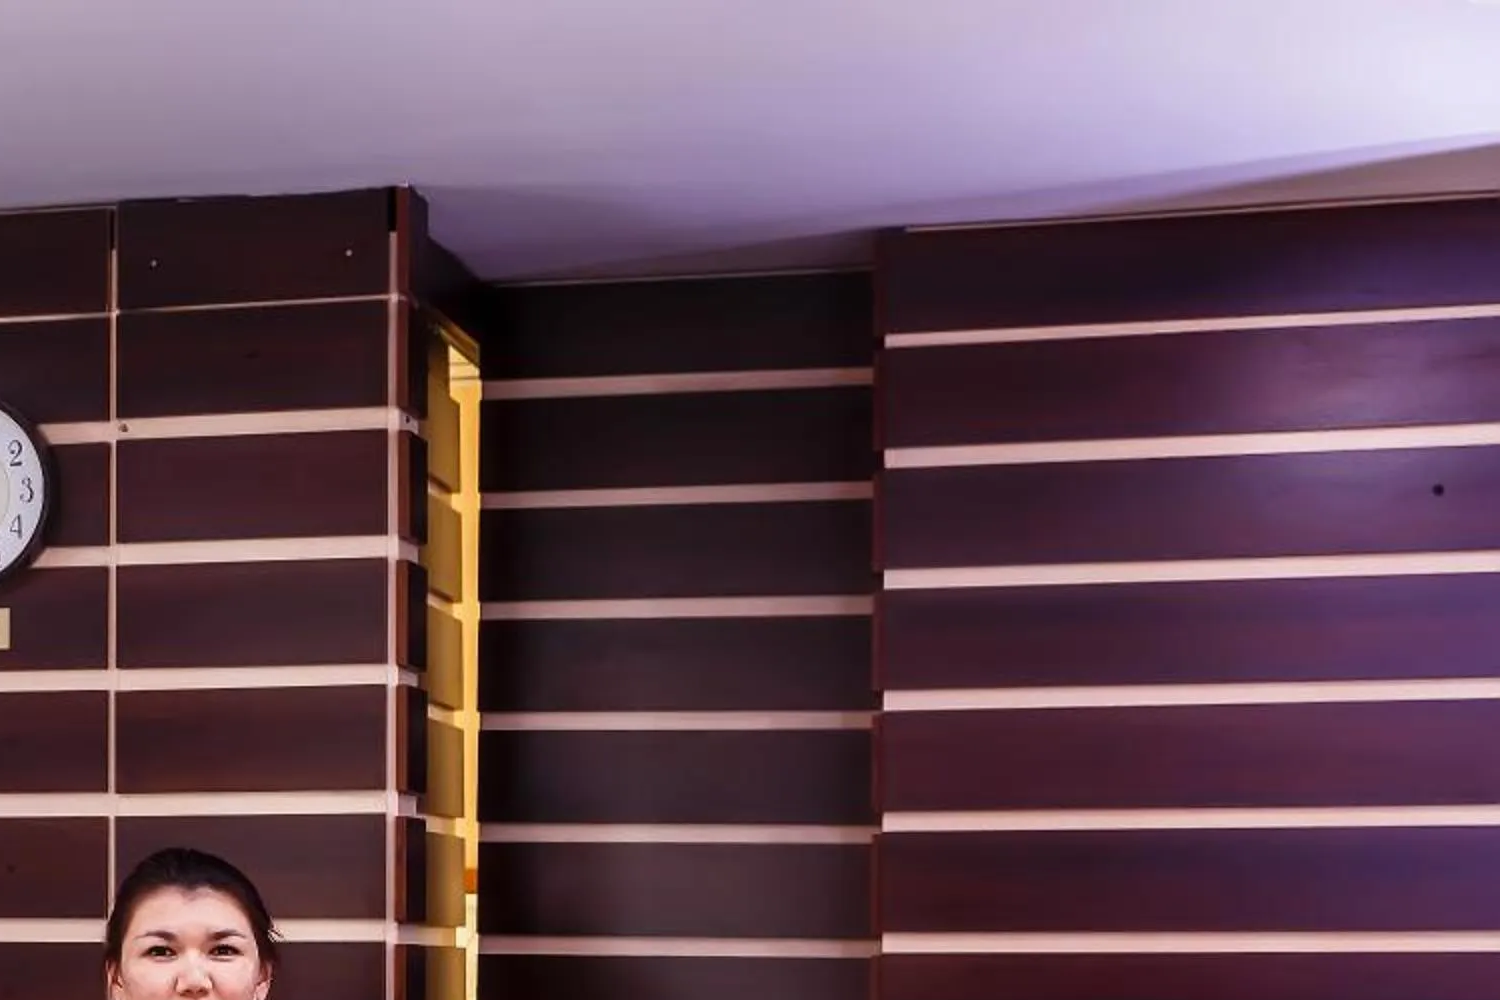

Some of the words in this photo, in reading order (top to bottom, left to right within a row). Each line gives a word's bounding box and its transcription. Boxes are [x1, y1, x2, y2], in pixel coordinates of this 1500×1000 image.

[7, 440, 23, 467] 2
[19, 477, 34, 503] 3
[9, 514, 23, 539] 4
